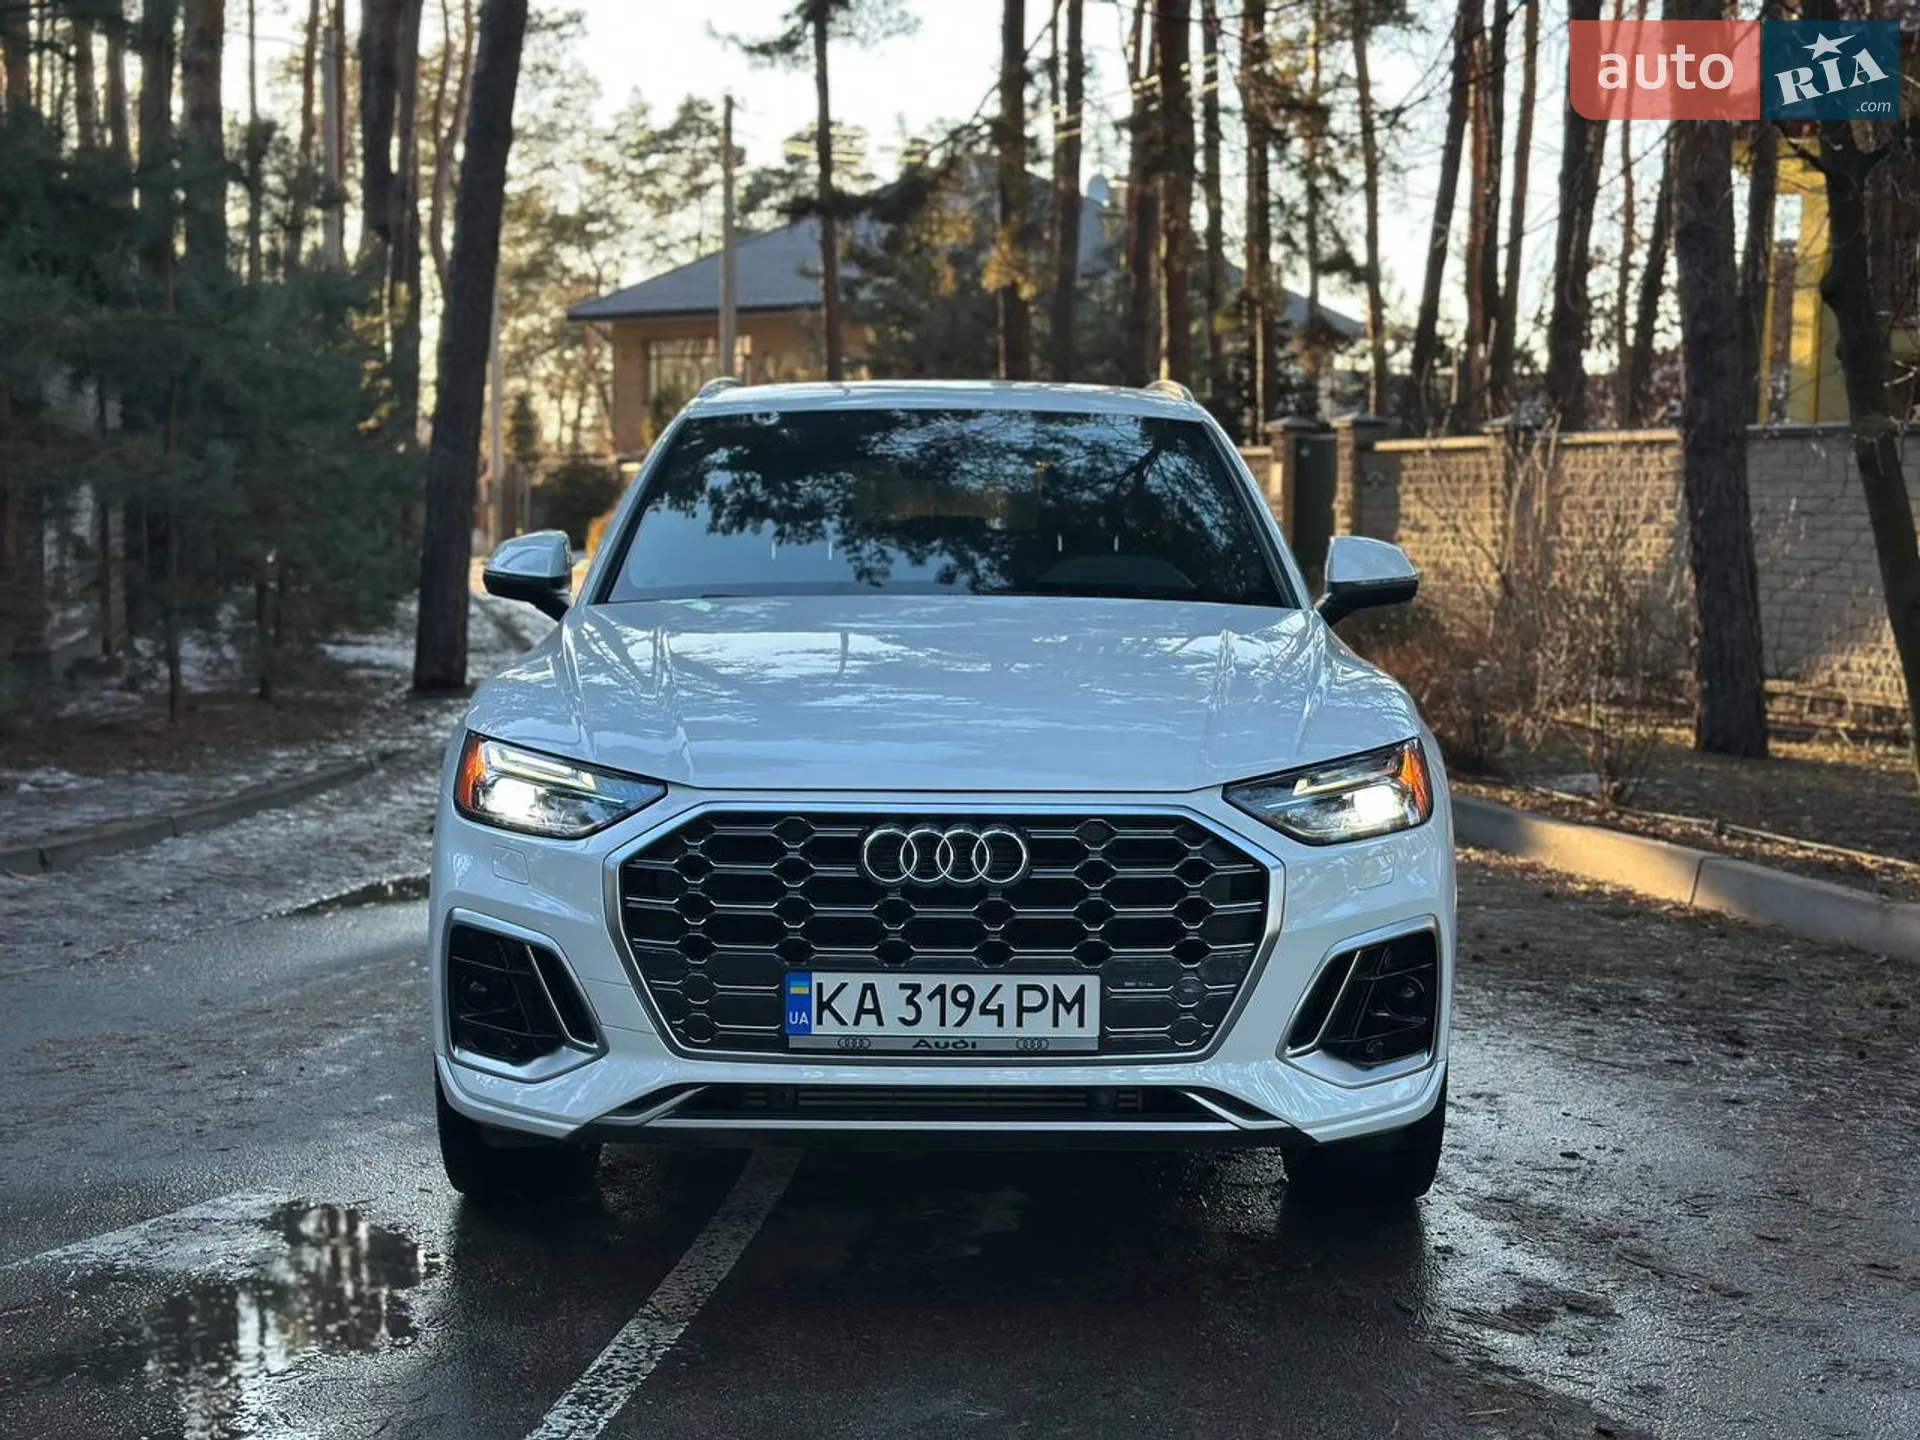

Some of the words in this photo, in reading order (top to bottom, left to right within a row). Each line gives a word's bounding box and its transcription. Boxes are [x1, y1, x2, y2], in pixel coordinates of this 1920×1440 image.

[815, 982, 884, 1027] KA
[897, 983, 1005, 1028] 3194
[1016, 984, 1086, 1029] PM
[789, 1012, 809, 1025] UA
[912, 1038, 977, 1050] Audi
